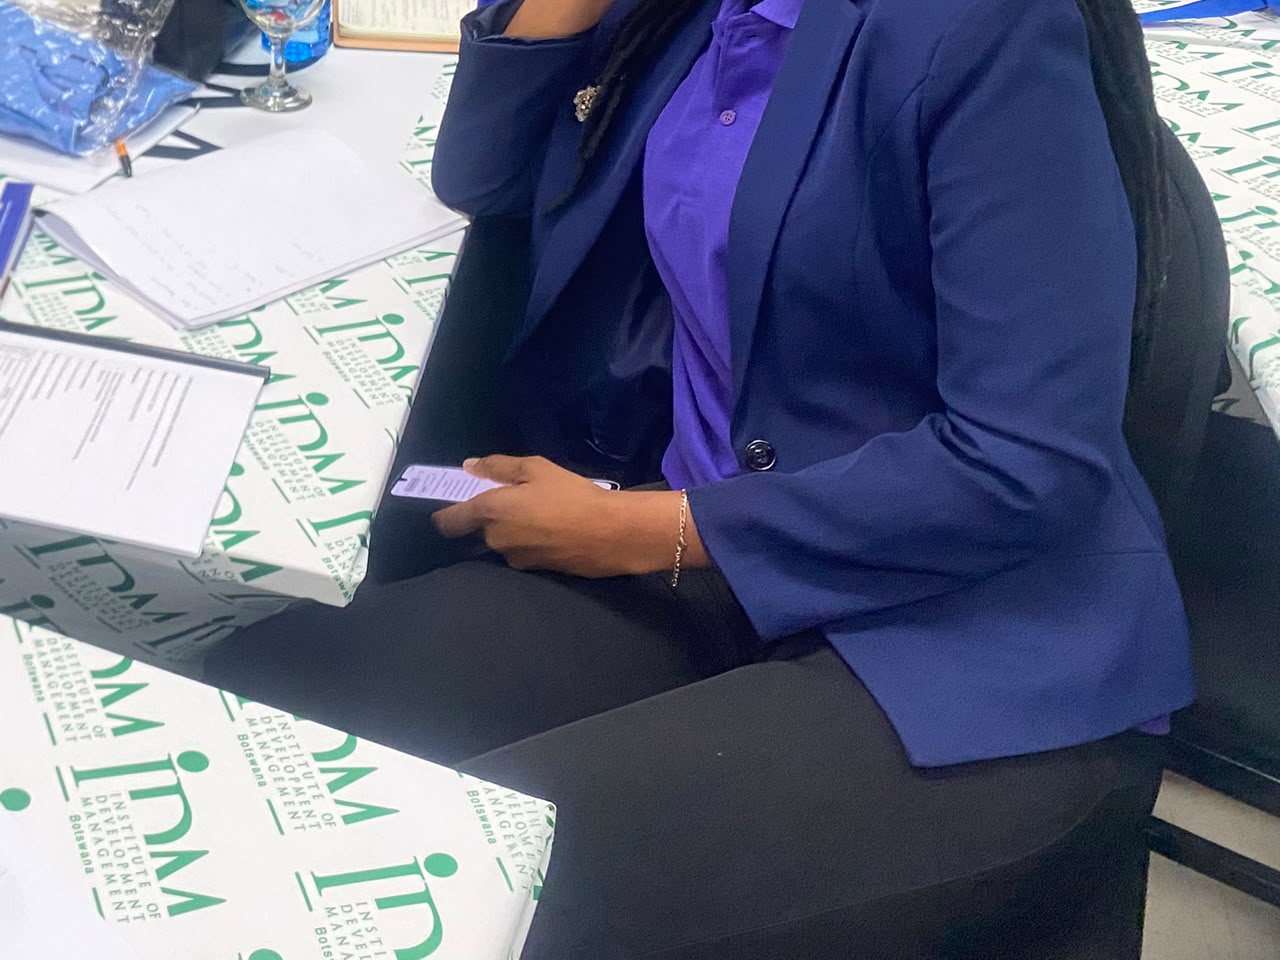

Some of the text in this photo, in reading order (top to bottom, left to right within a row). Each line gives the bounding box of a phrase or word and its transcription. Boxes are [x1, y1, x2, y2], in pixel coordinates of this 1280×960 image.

[255, 391, 368, 495] IDM
[23, 653, 46, 702] Botswana
[33, 638, 78, 743] MANAGEMENT
[46, 636, 92, 741] DEVELOPMENT
[92, 724, 107, 739] OF
[237, 733, 267, 788] Botswana
[246, 717, 306, 833] MANAGEMENT
[259, 715, 321, 830] DEVELOPMENT
[274, 714, 337, 828] INSTITUTE OF
[70, 750, 227, 917] IDM
[70, 814, 94, 874] Botswana
[80, 796, 130, 923] MANAGEMENT
[95, 794, 145, 921] DEVELOPMENT
[109, 792, 161, 919] INSTITUTE OF
[466, 789, 497, 844] Botswana
